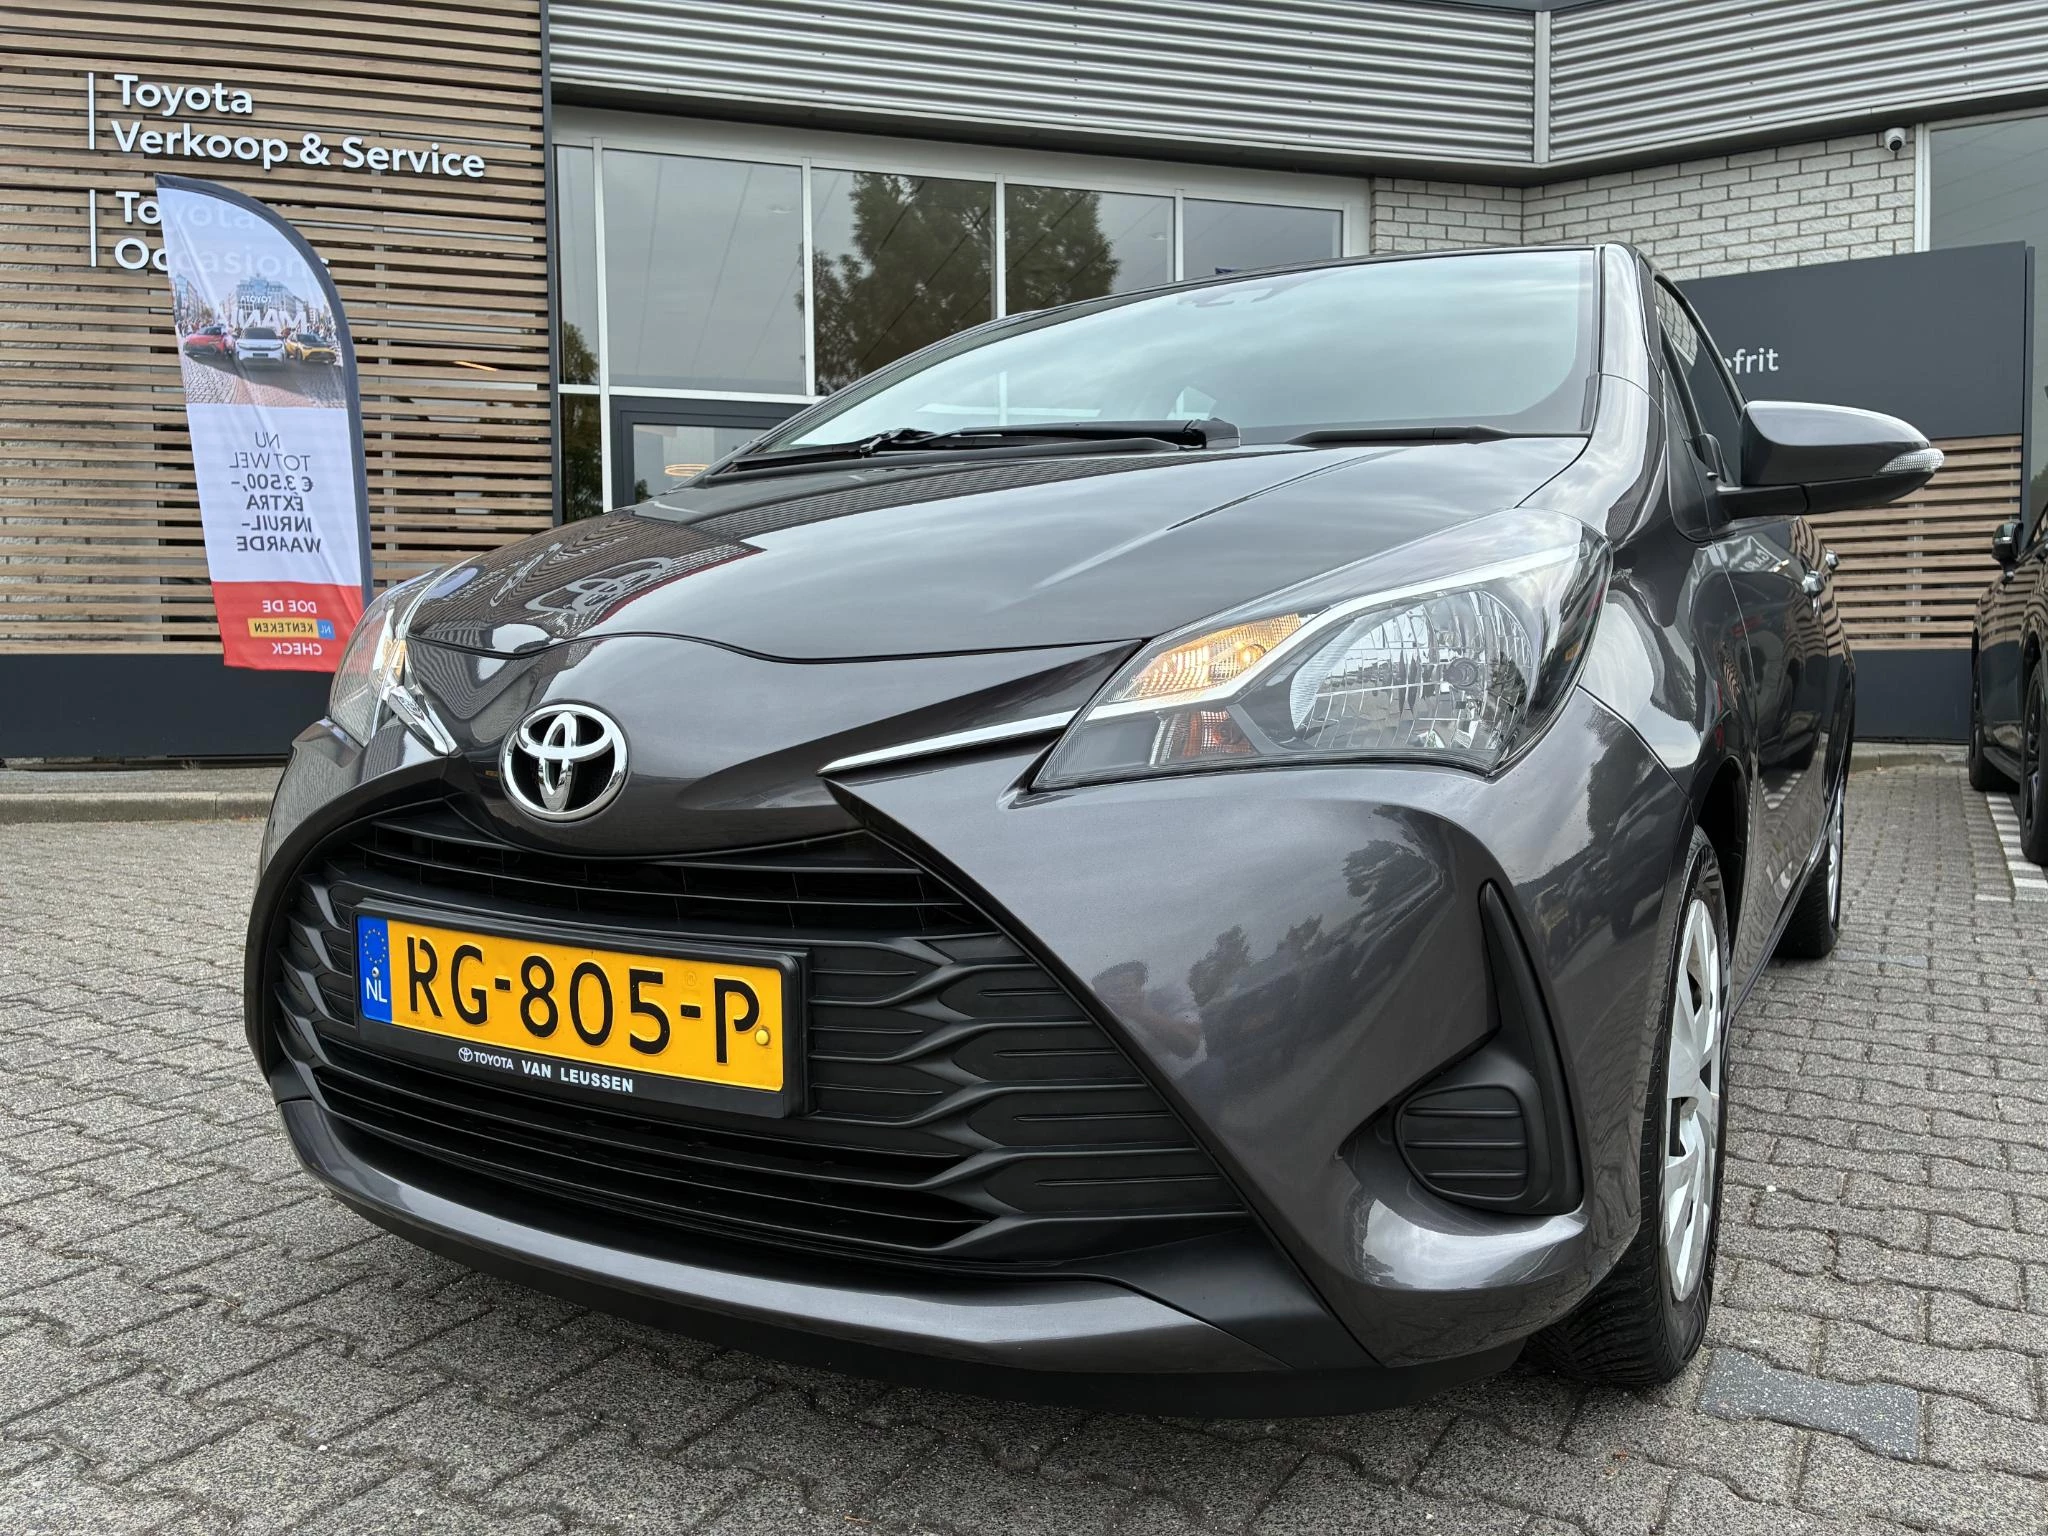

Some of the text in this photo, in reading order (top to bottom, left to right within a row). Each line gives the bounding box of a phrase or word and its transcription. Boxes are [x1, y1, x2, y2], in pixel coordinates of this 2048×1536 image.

[114, 74, 254, 117] Toyota
[111, 120, 486, 179] Verkoop & Service
[1724, 347, 1780, 375] frit
[365, 976, 389, 1005] NL
[405, 935, 763, 1066] RG-805-P
[473, 1051, 634, 1094] TOYOTA VAN LEUSSEN
